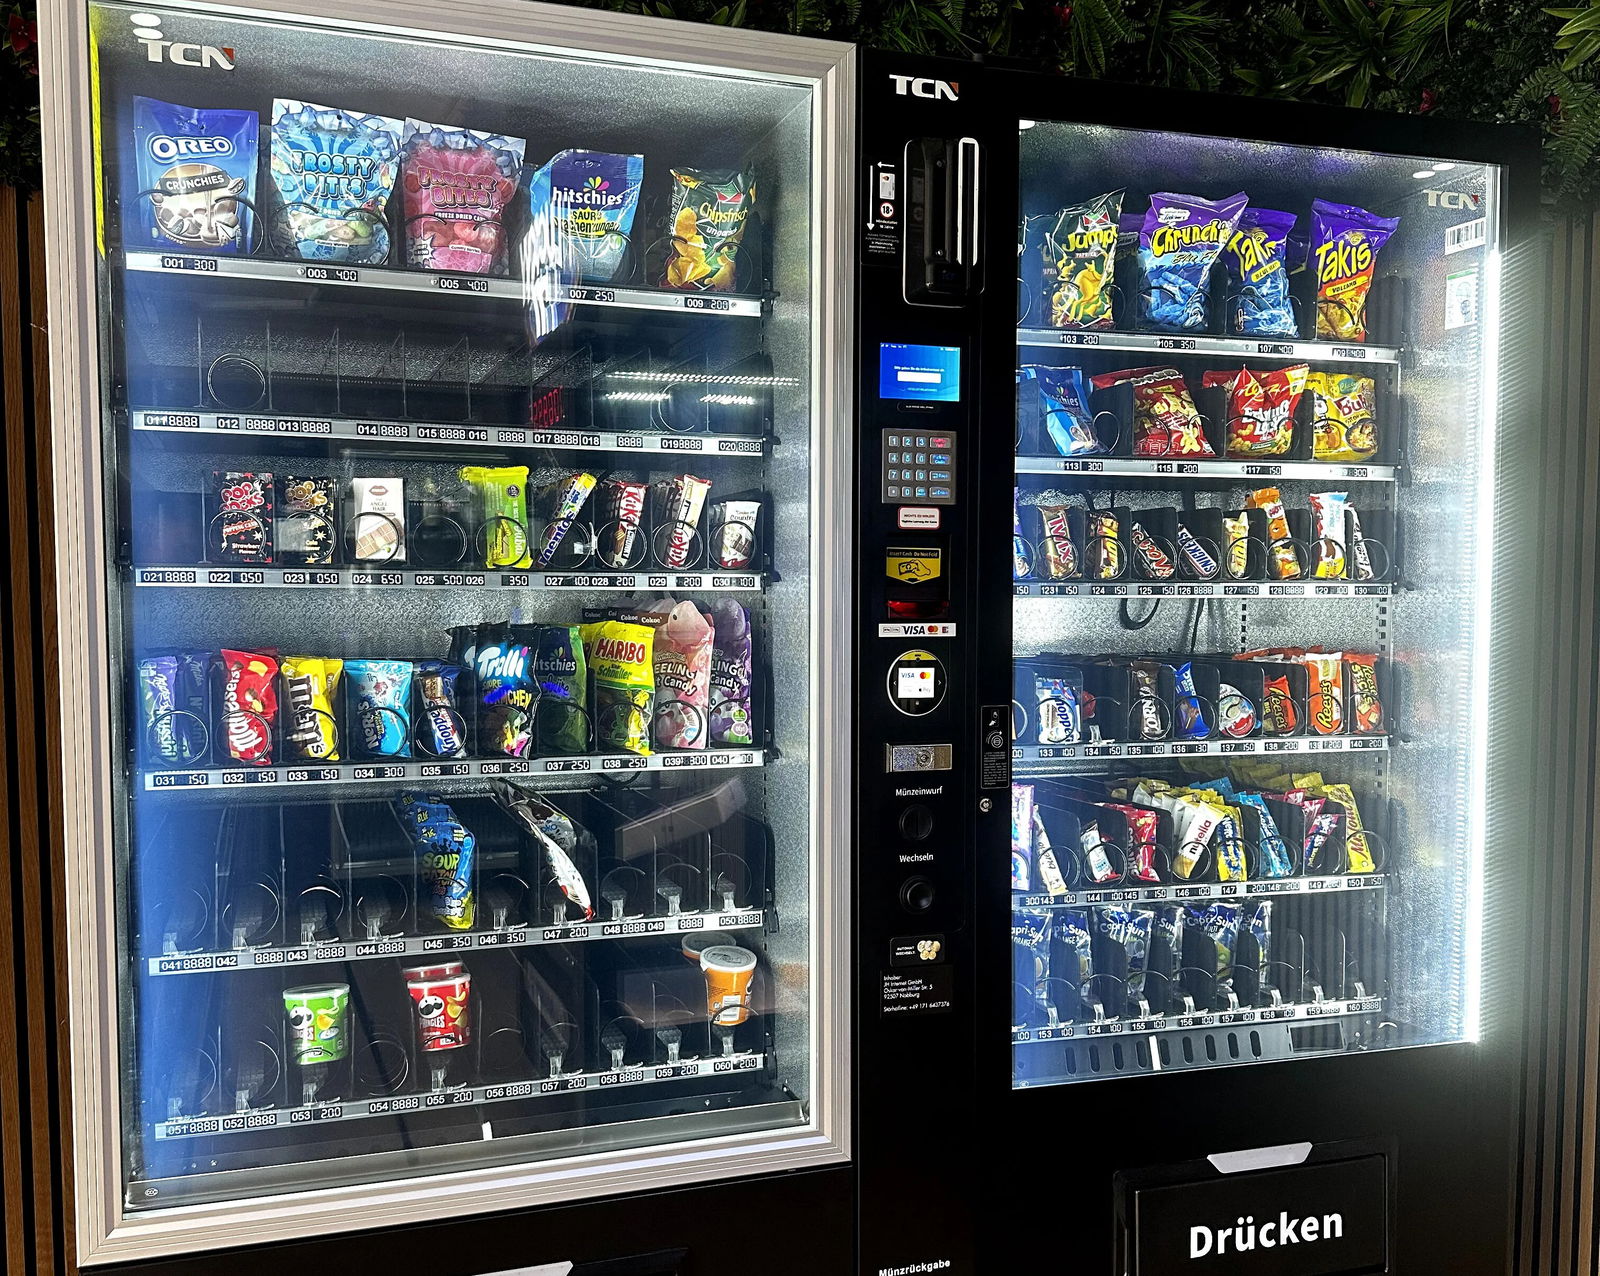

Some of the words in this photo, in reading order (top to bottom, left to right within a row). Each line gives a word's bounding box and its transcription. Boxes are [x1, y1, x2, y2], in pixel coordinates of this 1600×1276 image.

[137, 38, 235, 70] TCN
[889, 74, 958, 101] TCN
[152, 137, 231, 156] OREO
[293, 151, 375, 176] FROSTY
[165, 174, 224, 191] CRUNCHIES
[418, 167, 497, 191] FROSTY
[304, 174, 364, 198] BITES
[431, 186, 491, 206] BITES
[553, 187, 622, 206] hitschies
[1423, 190, 1478, 210] TCN
[164, 257, 184, 268] 001
[1316, 240, 1372, 290] Takis
[307, 269, 327, 279] 003
[440, 279, 459, 290] 005
[569, 289, 586, 299] 007
[687, 299, 703, 308] 009
[1160, 340, 1173, 348] 105
[218, 419, 238, 428] 012
[279, 421, 298, 431] 013
[358, 424, 377, 434] 014
[418, 427, 437, 437] 015
[469, 431, 486, 440] 016
[534, 434, 551, 443] 017
[582, 436, 599, 445] 018
[662, 439, 678, 448] 019
[720, 442, 736, 450] 020
[538, 510, 576, 566] mentos
[1048, 512, 1073, 563] TWIX
[143, 572, 162, 581] 021
[210, 573, 230, 583] 022
[284, 574, 304, 583] 023
[353, 574, 372, 584] 024
[416, 575, 434, 584] 025
[466, 576, 483, 585] 026
[546, 576, 563, 585] 027
[592, 576, 608, 586] 028
[650, 577, 666, 586] 029
[714, 577, 730, 586] 030
[1225, 586, 1237, 594] 127
[902, 626, 925, 635] VISA
[594, 638, 646, 664] HARIBO
[478, 646, 528, 678] Trolli
[664, 675, 696, 696] Candy
[1316, 679, 1333, 728] Reese's
[1222, 744, 1235, 752] 137
[604, 760, 621, 768] 038
[665, 757, 680, 766] 039
[712, 756, 728, 764] 040
[423, 766, 441, 775] 035
[482, 764, 499, 773] 036
[547, 762, 563, 771] 037
[289, 772, 308, 781] 033
[355, 769, 374, 778] 034
[156, 776, 175, 785] 031
[224, 774, 243, 783] 032
[896, 786, 943, 796] Münzeinwurf
[1189, 819, 1212, 855] nutella
[899, 853, 933, 862] Wechseln
[720, 917, 736, 925] 050
[604, 925, 621, 934] 048
[648, 922, 664, 930] 049
[544, 930, 560, 939] 047
[424, 940, 442, 949] 045
[480, 935, 497, 945] 046
[357, 945, 376, 955] 044
[288, 950, 307, 961] 043
[217, 957, 236, 967] 042
[1308, 1007, 1320, 1015] 159
[715, 1062, 730, 1070] 060
[657, 1069, 673, 1077] 059
[601, 1075, 617, 1084] 058
[542, 1082, 559, 1091] 057
[487, 1088, 504, 1098] 056
[427, 1096, 445, 1105] 055
[370, 1101, 388, 1111] 054
[292, 1111, 311, 1122] 053
[224, 1118, 243, 1128] 052
[1190, 1211, 1342, 1259] Drücken
[879, 1260, 951, 1276] Münzrückgabe
